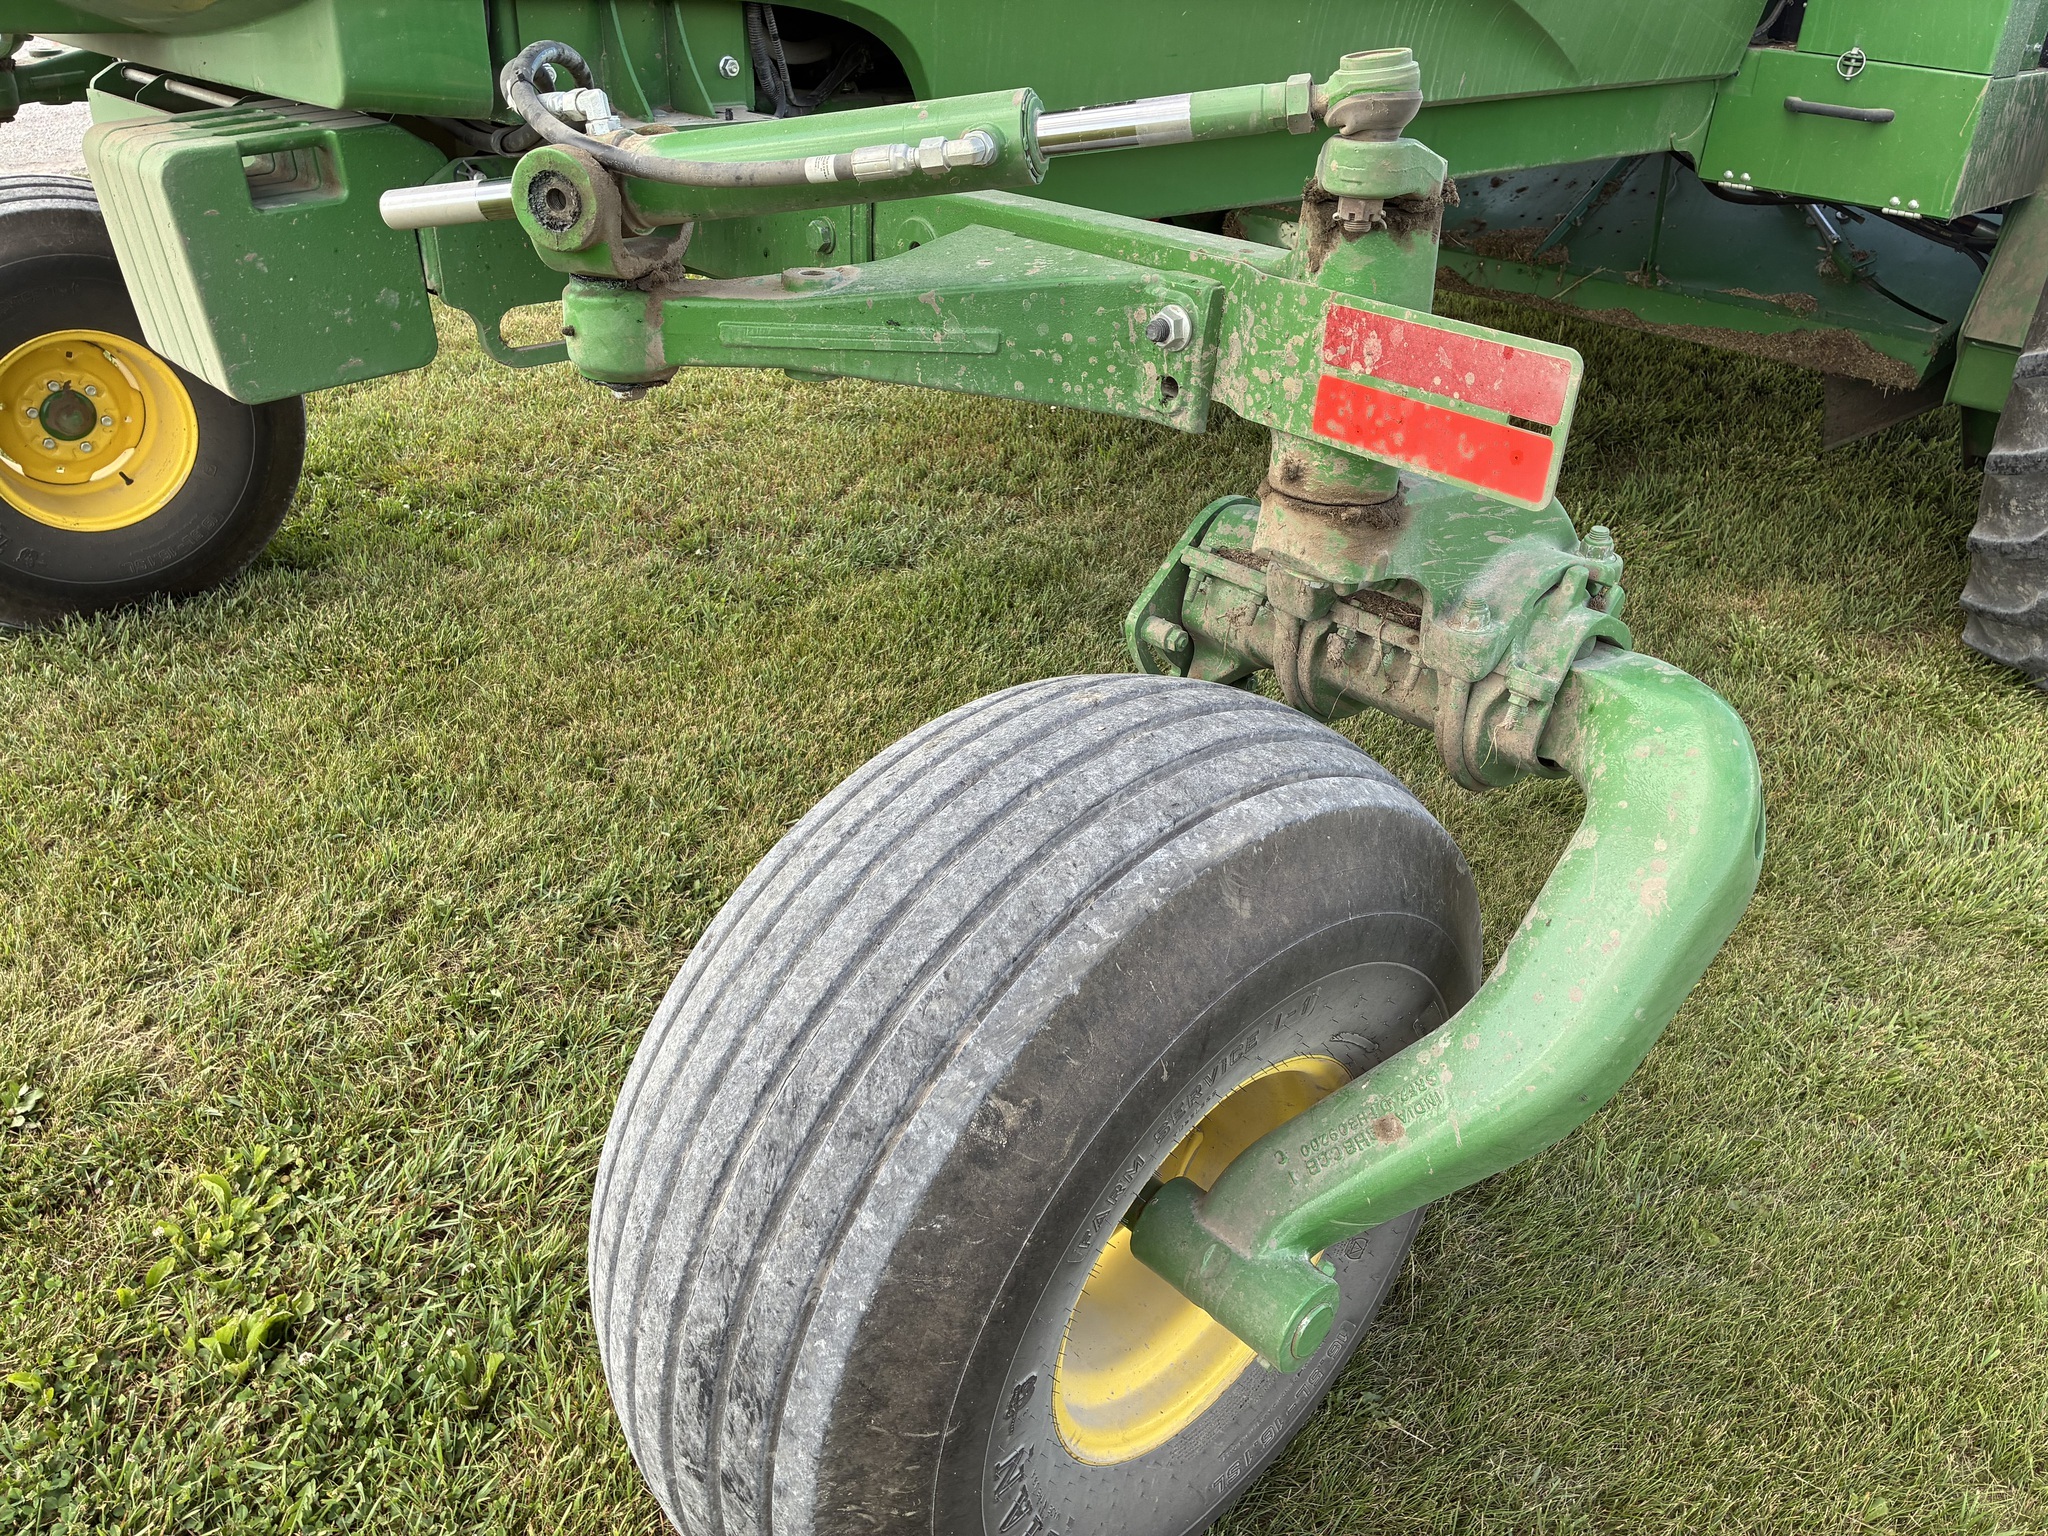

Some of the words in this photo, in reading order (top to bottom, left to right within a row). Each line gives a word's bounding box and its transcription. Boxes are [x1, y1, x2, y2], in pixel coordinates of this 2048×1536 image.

[1079, 1154, 1146, 1253] FARM
[1153, 1030, 1260, 1145] SERVICE
[1395, 1091, 1443, 1125] INDIA
[1211, 1331, 1349, 1494] 16.5L-16.1SL
